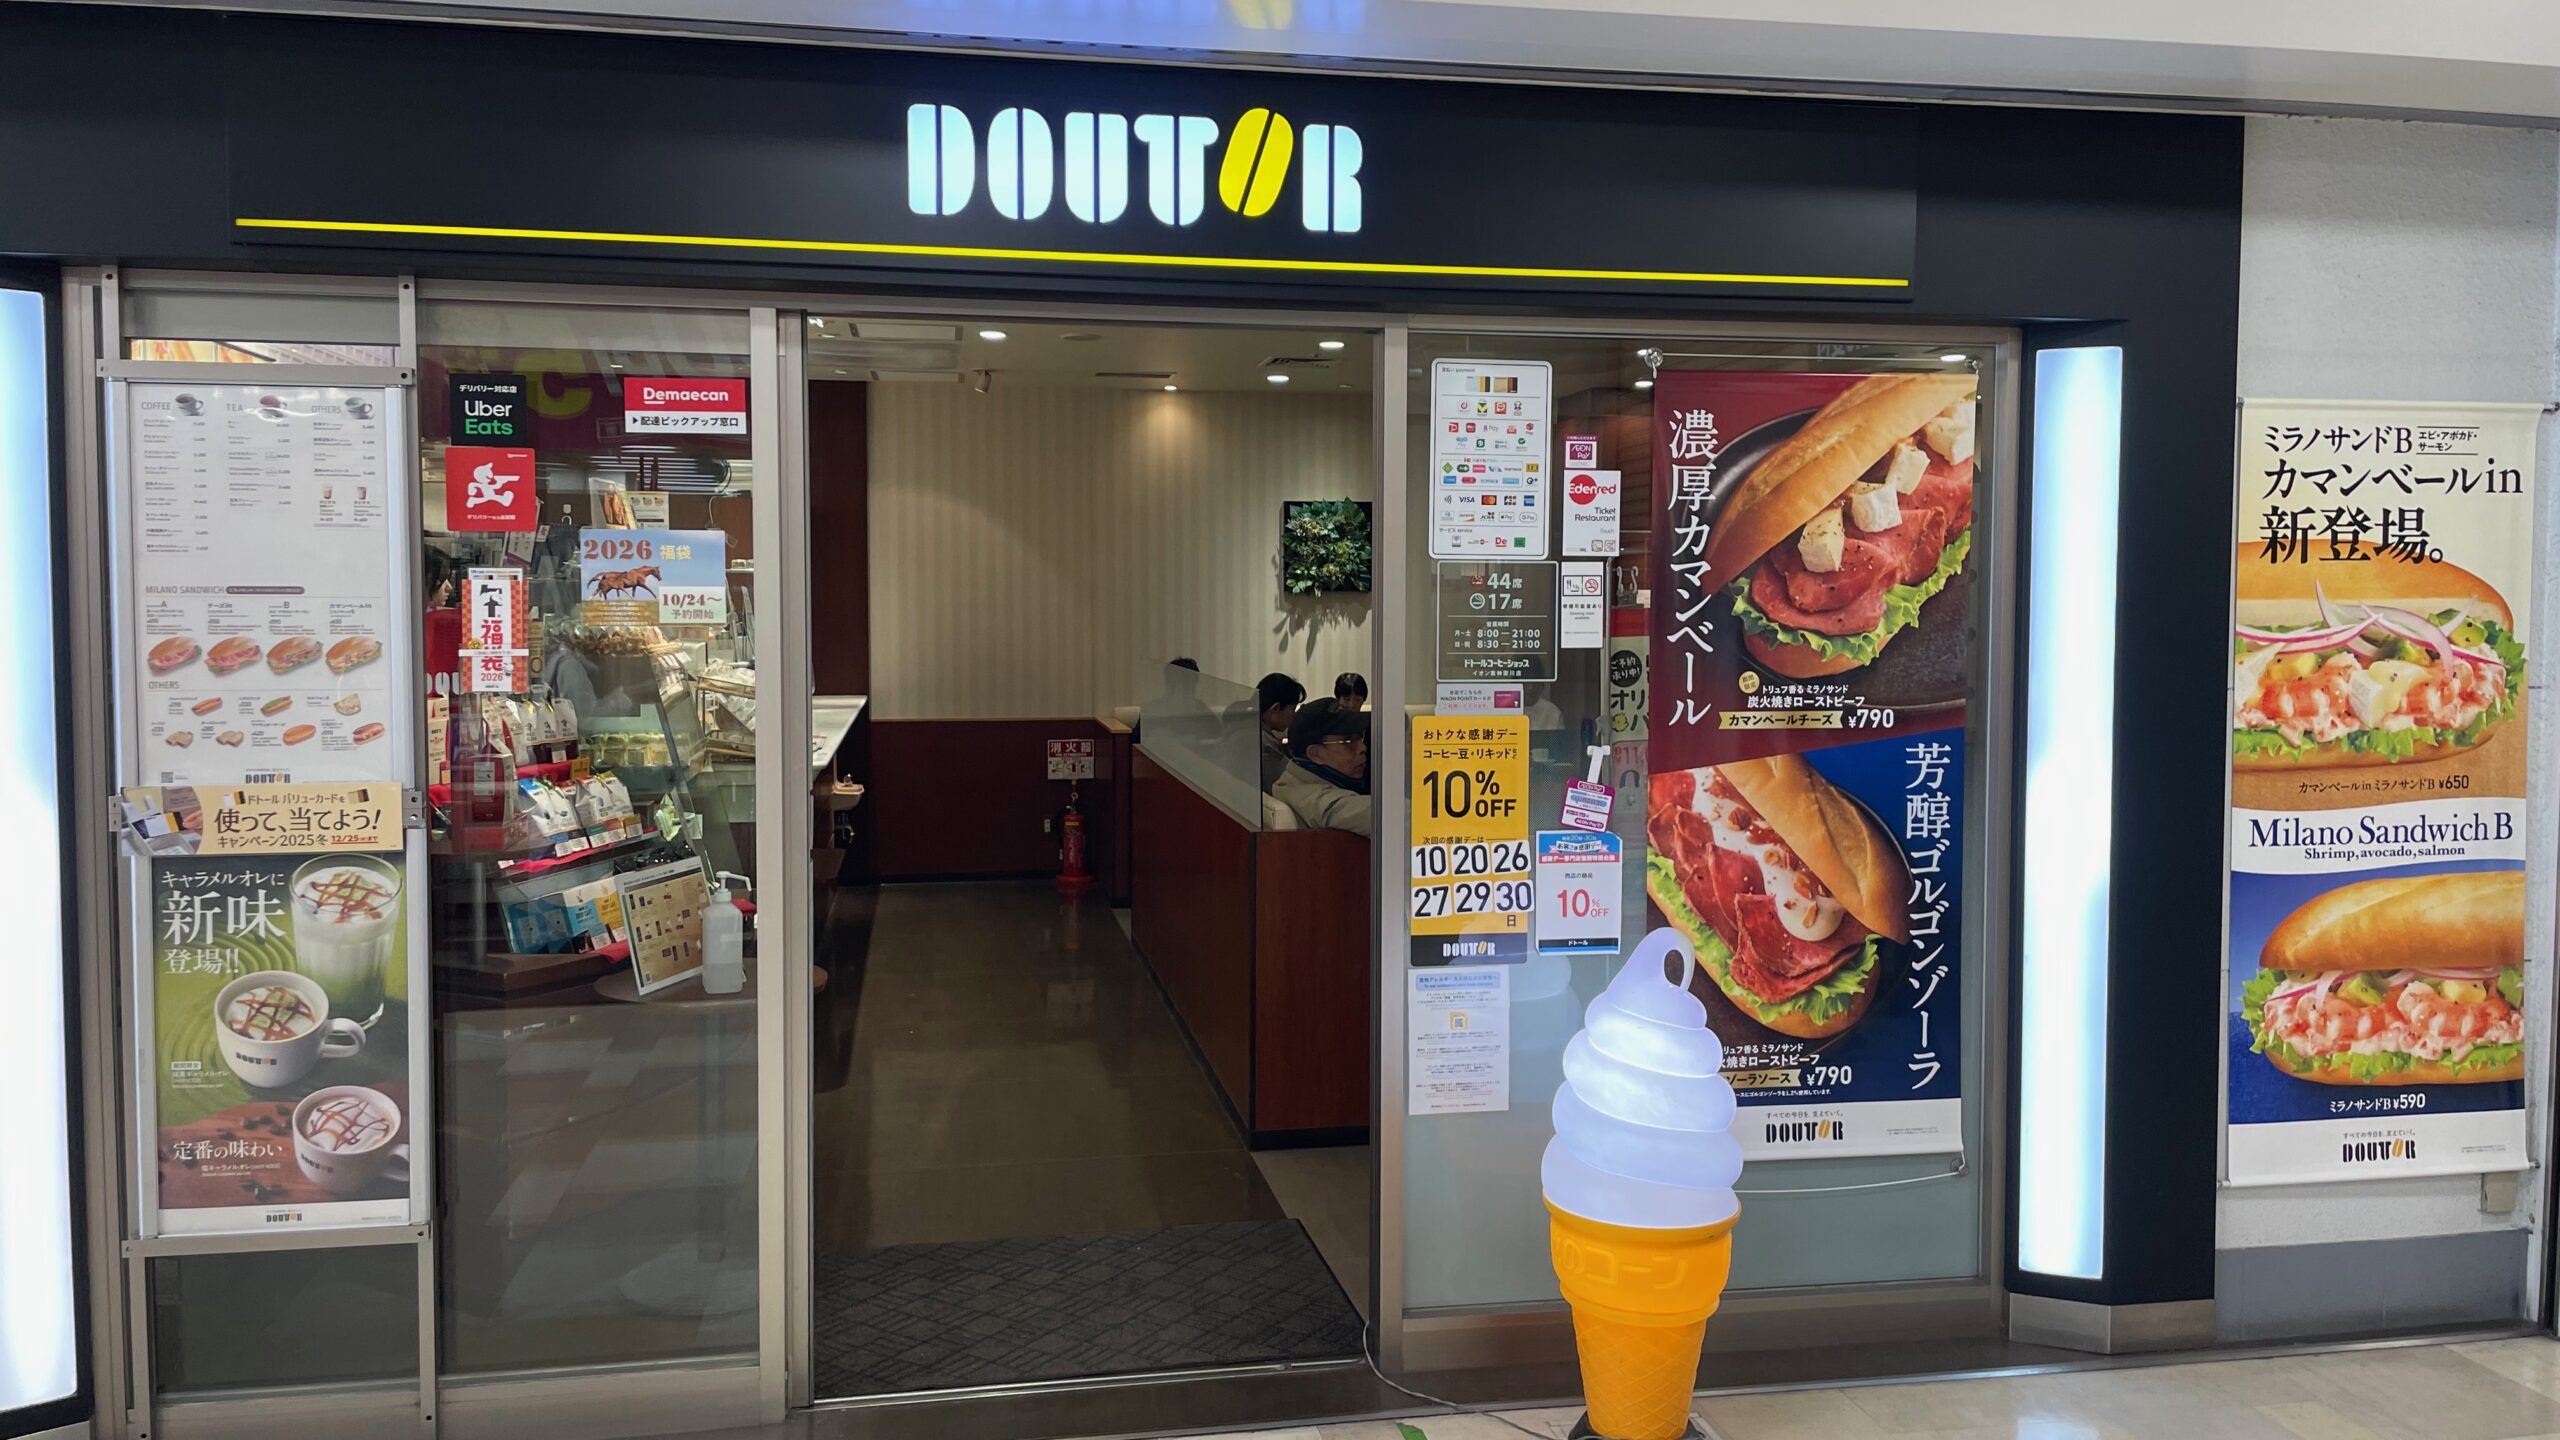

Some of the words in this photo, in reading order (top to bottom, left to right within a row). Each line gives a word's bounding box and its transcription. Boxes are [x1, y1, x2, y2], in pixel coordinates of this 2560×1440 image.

[908, 103, 1362, 232] DOUTOR
[459, 384, 518, 394] デリバリー対応店
[643, 387, 729, 402] Demaecan
[464, 400, 512, 417] Uber
[465, 418, 513, 436] Eats
[640, 416, 739, 428] 配達ピックアップ窓口
[2264, 426, 2412, 454] ミラノサンドB
[2418, 442, 2453, 451] サーモン
[2262, 457, 2524, 499] カマンベールin
[1568, 483, 1617, 495] Edenred
[1574, 514, 1616, 522] Restaurant
[1594, 507, 1616, 515] Ticket
[1495, 537, 1508, 545] De
[2259, 505, 2444, 564] 新登場。
[583, 539, 653, 560] 2026
[659, 545, 692, 560] 福袋
[1667, 409, 1719, 727] 濃厚カマンベール
[145, 585, 178, 595] MILANO
[180, 585, 225, 595] SANDWICH
[671, 609, 715, 621] 予約開始
[1477, 629, 1499, 638] 8:00
[1512, 629, 1540, 638] 21:00
[1477, 640, 1499, 648] 8:30
[1512, 640, 1540, 648] 21:00
[481, 673, 503, 682] 2026
[1762, 685, 1804, 694] トリュフ香る
[1806, 684, 1849, 694] ミラノサンド
[1747, 696, 1866, 708] 炭火焼きローストビーフ
[1729, 714, 1834, 726] カマンベールチーズ
[1848, 709, 1894, 728] ¥790
[1423, 728, 1518, 740] おトクな感謝デー
[2438, 775, 2469, 790] ¥650
[248, 794, 279, 806] ドトール
[282, 792, 345, 806] バリューカードを
[1475, 799, 1517, 817] OFF
[215, 808, 381, 833] 使って、当てよう!
[2249, 816, 2353, 848] Milano
[2359, 812, 2488, 845] Sandwich
[2494, 812, 2513, 841] B
[217, 834, 327, 847] キャンペーン2025冬
[1423, 836, 1485, 844] 次回の感謝デーは
[1415, 846, 1446, 876] 10
[1453, 844, 1488, 875] 20
[1493, 842, 1529, 873] 26
[161, 870, 286, 888] キャラメルオレに
[1414, 886, 1449, 917] 27
[1455, 882, 1491, 912] 29
[1496, 881, 1532, 911] 30
[162, 889, 286, 945] 新味
[1590, 909, 1609, 917] OFF
[1905, 742, 1952, 1090] 芳醇ゴルゴンゾーラ
[1443, 941, 1496, 957] DOUTOR
[165, 948, 240, 973] 登場!!
[1721, 1045, 1759, 1056] リュフ香る
[1761, 1043, 1803, 1053] ミラノサンド
[1807, 1065, 1853, 1086] ¥790
[2329, 1097, 2391, 1112] ミラノサンドB
[2393, 1093, 2426, 1110] ¥590
[1766, 1119, 1844, 1144] DOUTOR
[172, 1140, 284, 1160] 定番の味わい
[2342, 1137, 2416, 1163] DOUTOR
